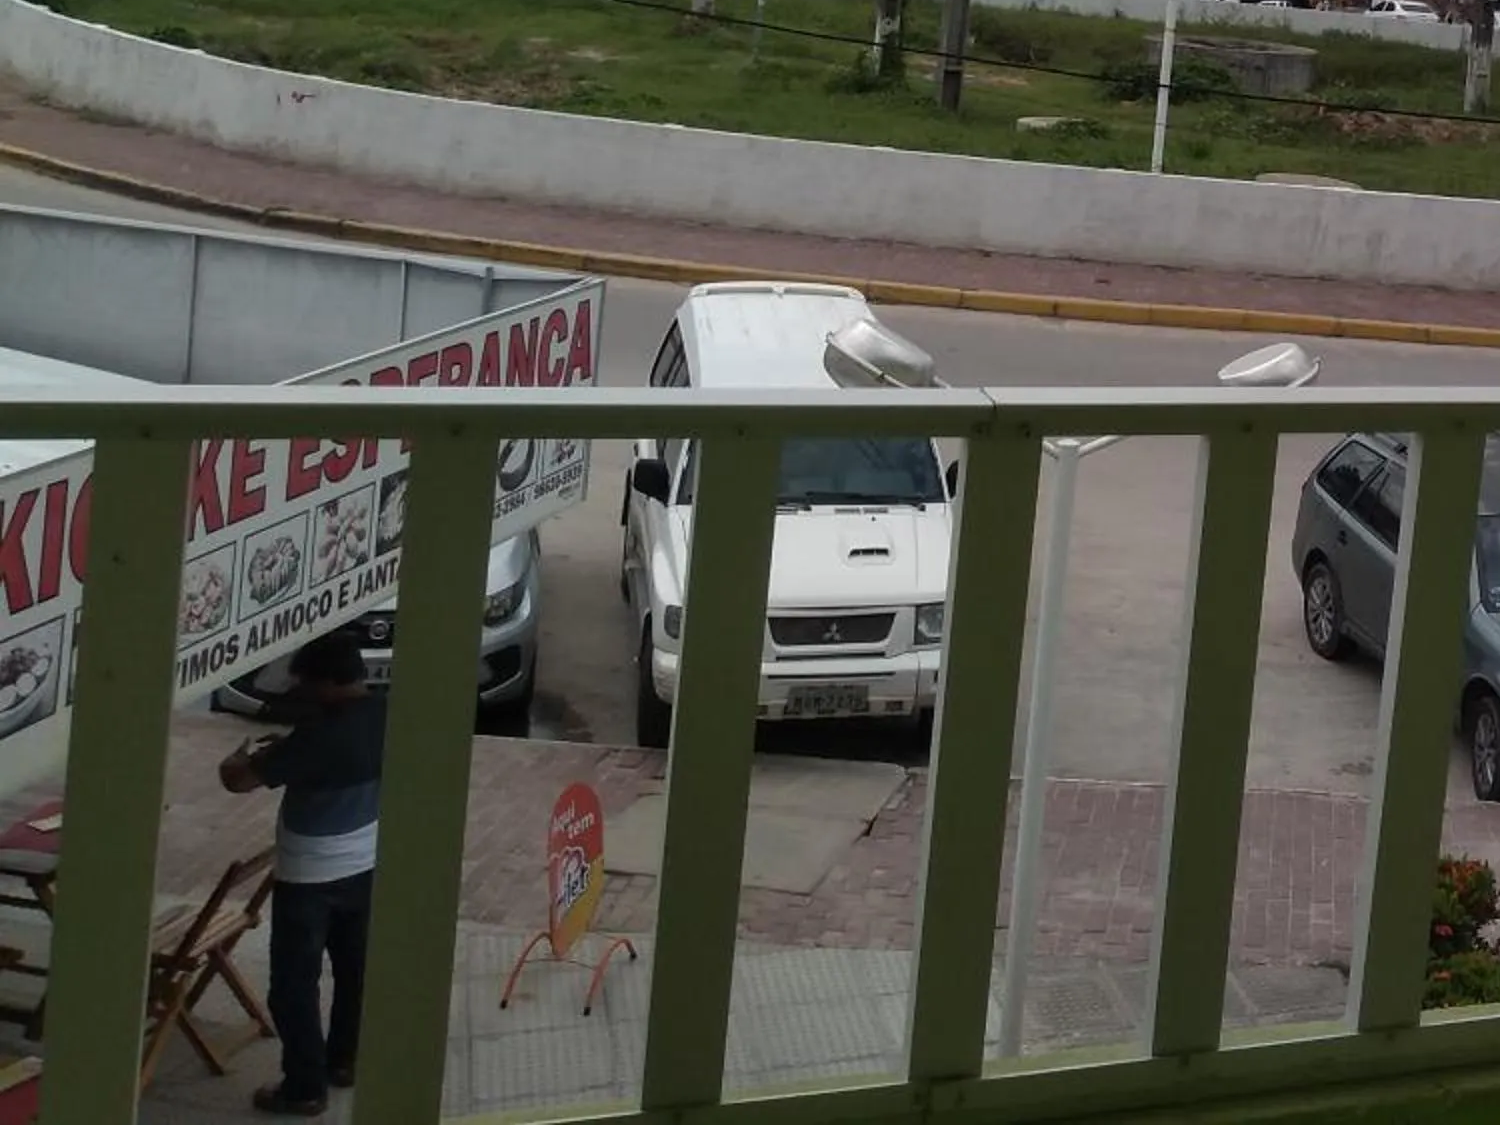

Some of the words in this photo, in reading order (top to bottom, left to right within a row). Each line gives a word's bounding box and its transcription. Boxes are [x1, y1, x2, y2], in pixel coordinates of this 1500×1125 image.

[244, 590, 333, 657] ALMOÇO
[337, 582, 350, 609] E
[353, 557, 400, 602] JANT
